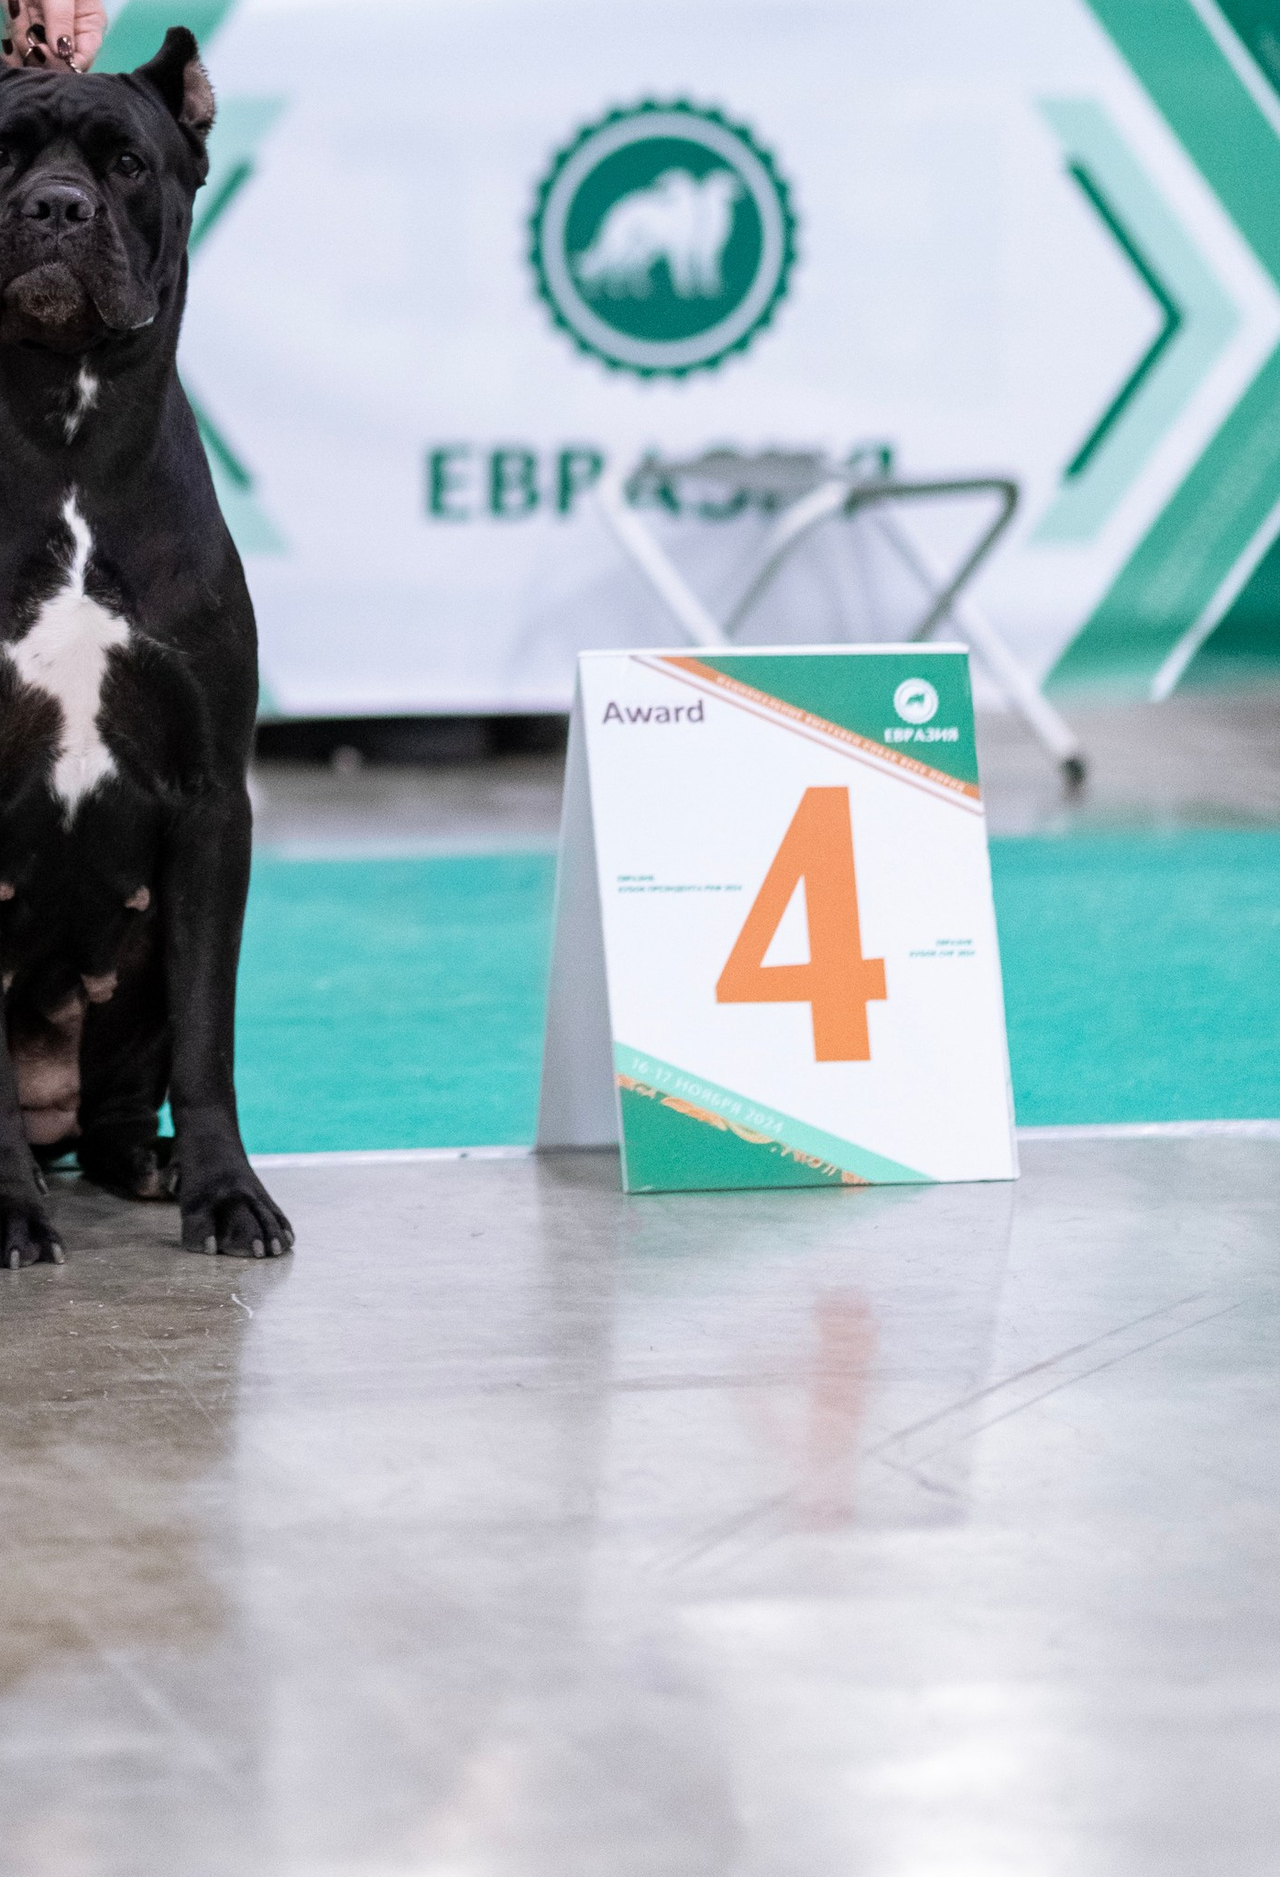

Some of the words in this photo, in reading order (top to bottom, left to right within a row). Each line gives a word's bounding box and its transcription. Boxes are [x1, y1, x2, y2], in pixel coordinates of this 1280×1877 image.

[603, 699, 705, 724] Award
[883, 726, 959, 743] ЕВРАЗИЯ
[715, 785, 888, 1062] 4
[744, 1107, 785, 1134] 2024
